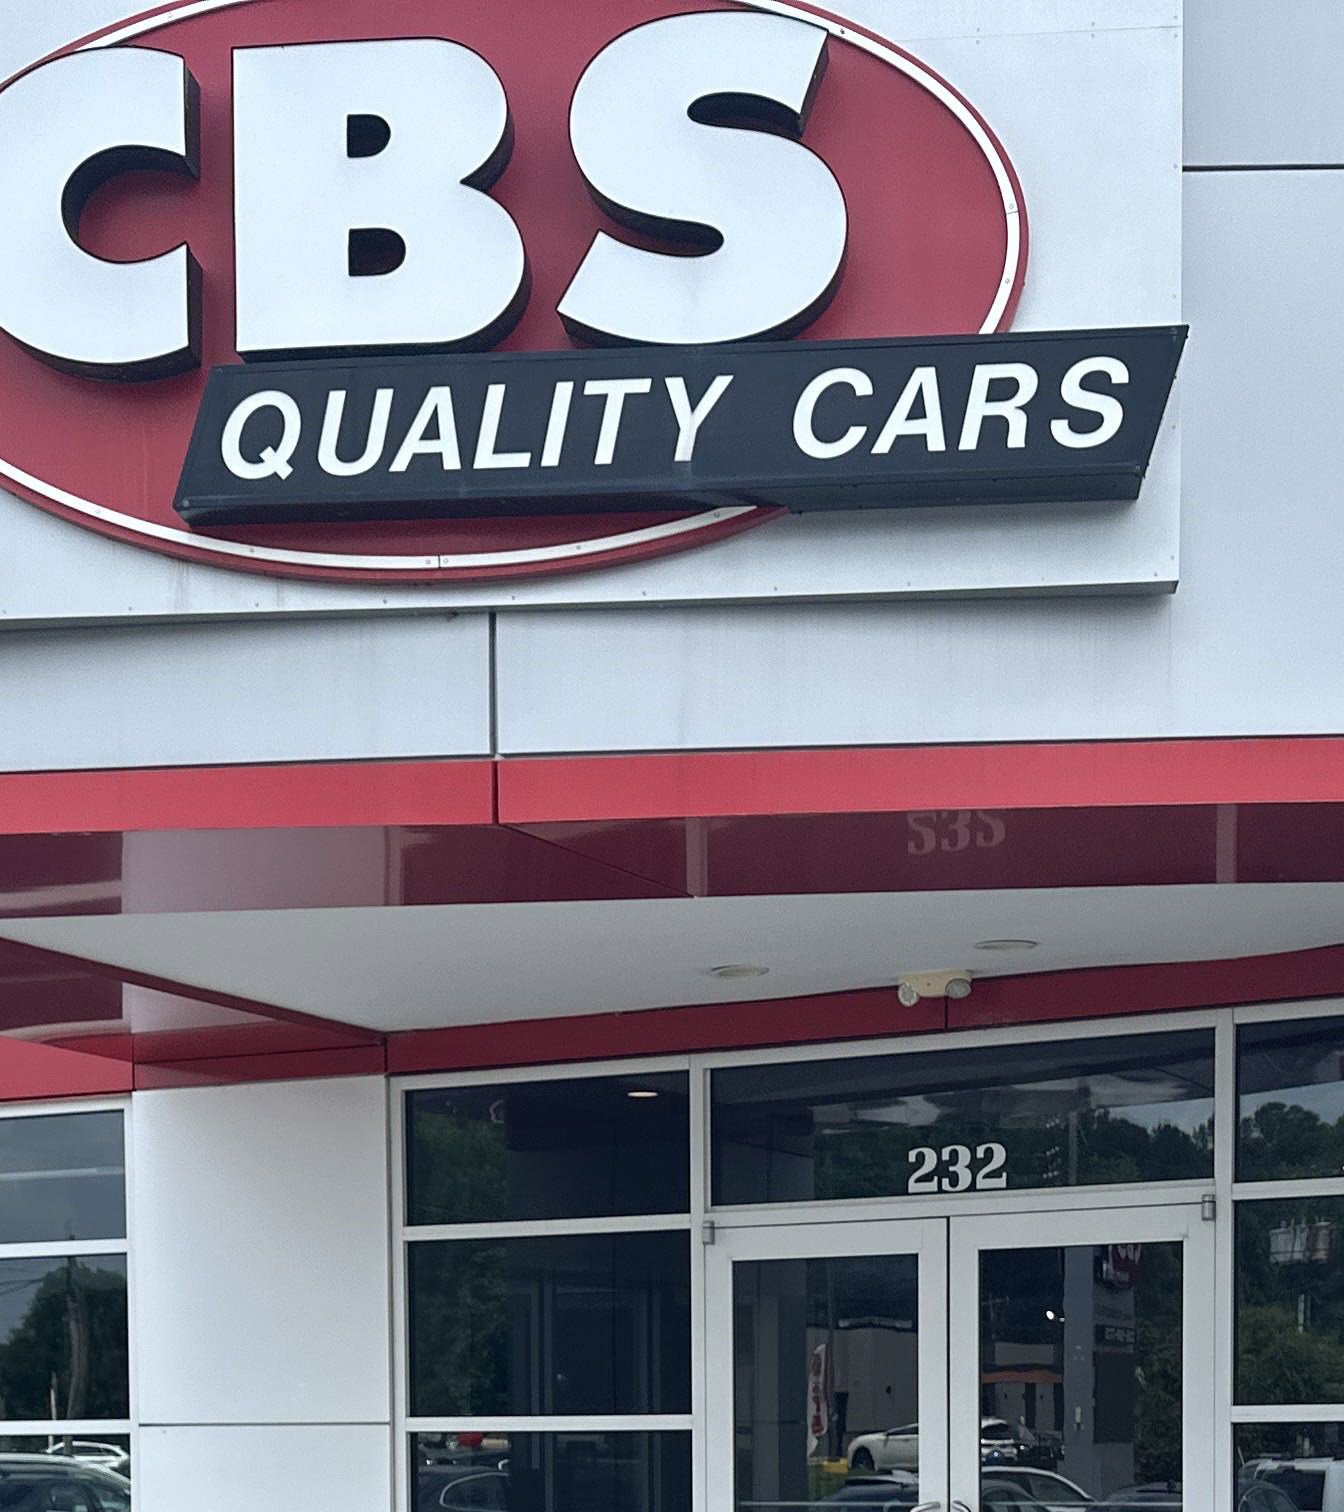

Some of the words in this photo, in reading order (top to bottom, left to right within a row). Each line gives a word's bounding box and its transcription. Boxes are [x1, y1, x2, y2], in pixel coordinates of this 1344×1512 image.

[219, 374, 735, 482] QUALITY
[791, 355, 1130, 462] CARS
[907, 1142, 1007, 1194] 232
